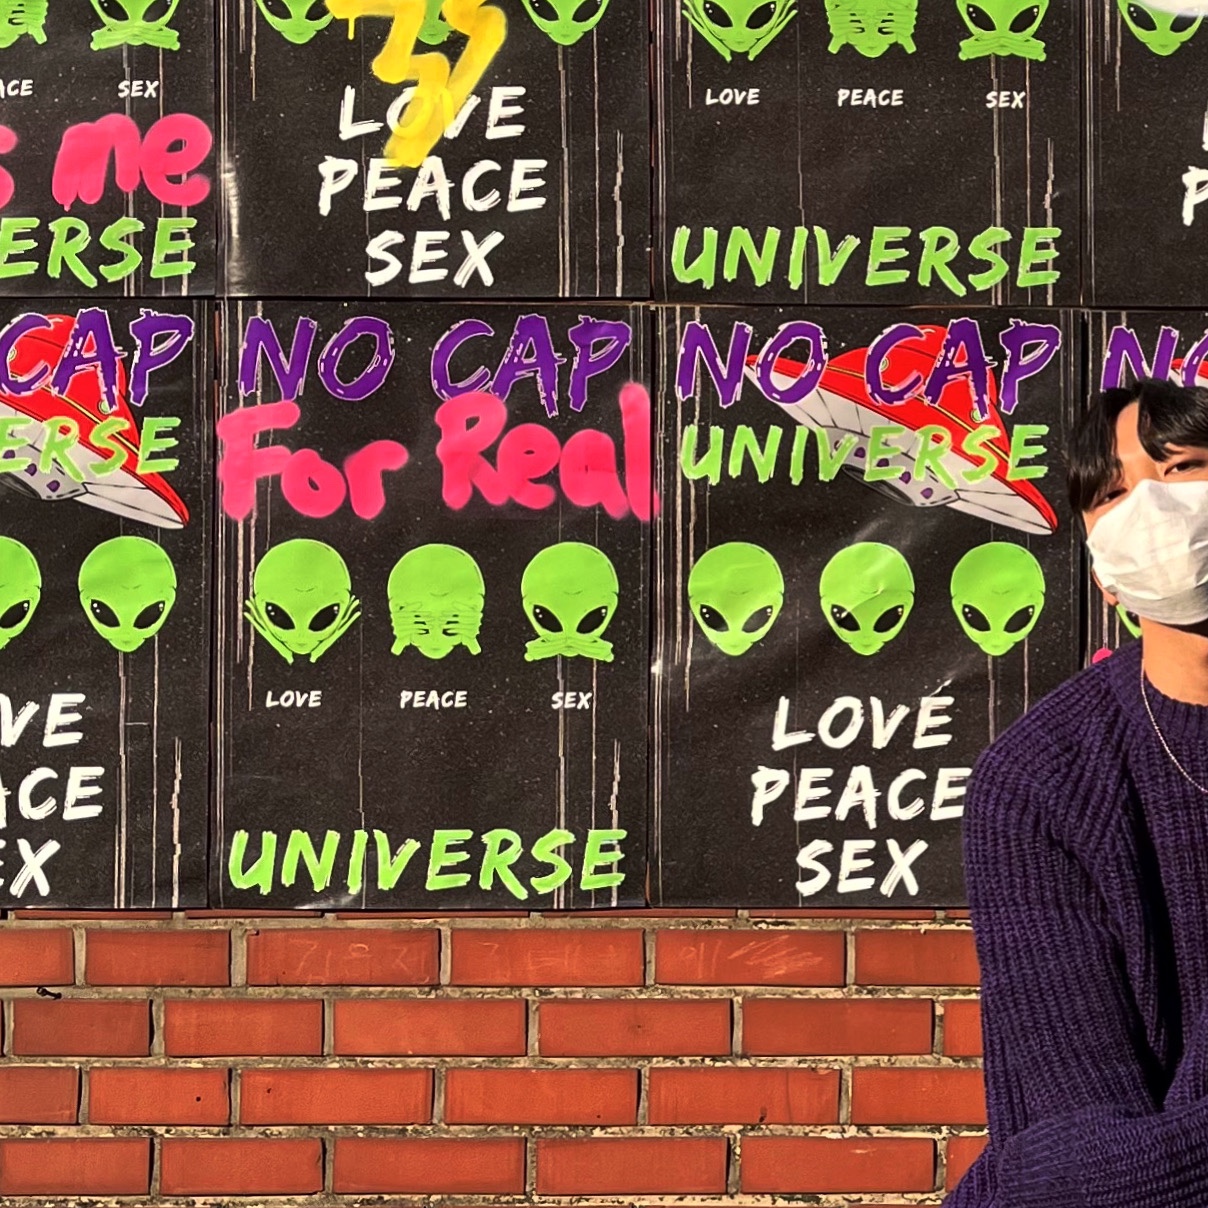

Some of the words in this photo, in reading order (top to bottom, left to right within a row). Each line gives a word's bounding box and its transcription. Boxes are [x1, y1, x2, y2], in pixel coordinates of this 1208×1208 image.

[117, 80, 159, 99] SEX
[338, 85, 526, 141] LOVE
[705, 88, 760, 106] LOVE
[837, 88, 904, 109] PEACE
[985, 90, 1026, 109] SEX
[51, 113, 212, 209] me
[318, 155, 548, 221] PEACE
[364, 229, 505, 288] SEX
[671, 226, 1060, 295] UNIVERSE
[0, 307, 195, 412] CAP
[238, 315, 395, 402] NO
[430, 314, 632, 417] CAP
[676, 321, 828, 408] NO
[864, 317, 1061, 419] CAP
[215, 399, 409, 521] For
[434, 382, 661, 522] Real
[680, 425, 1047, 490] UNIVERSE
[265, 690, 322, 708] LOVE
[400, 690, 468, 710] PEACE
[551, 691, 593, 710] SEX
[771, 695, 955, 751] LOVE
[751, 764, 973, 830] PEACE
[228, 829, 626, 899] UNIVERSE
[795, 838, 929, 898] SEX
